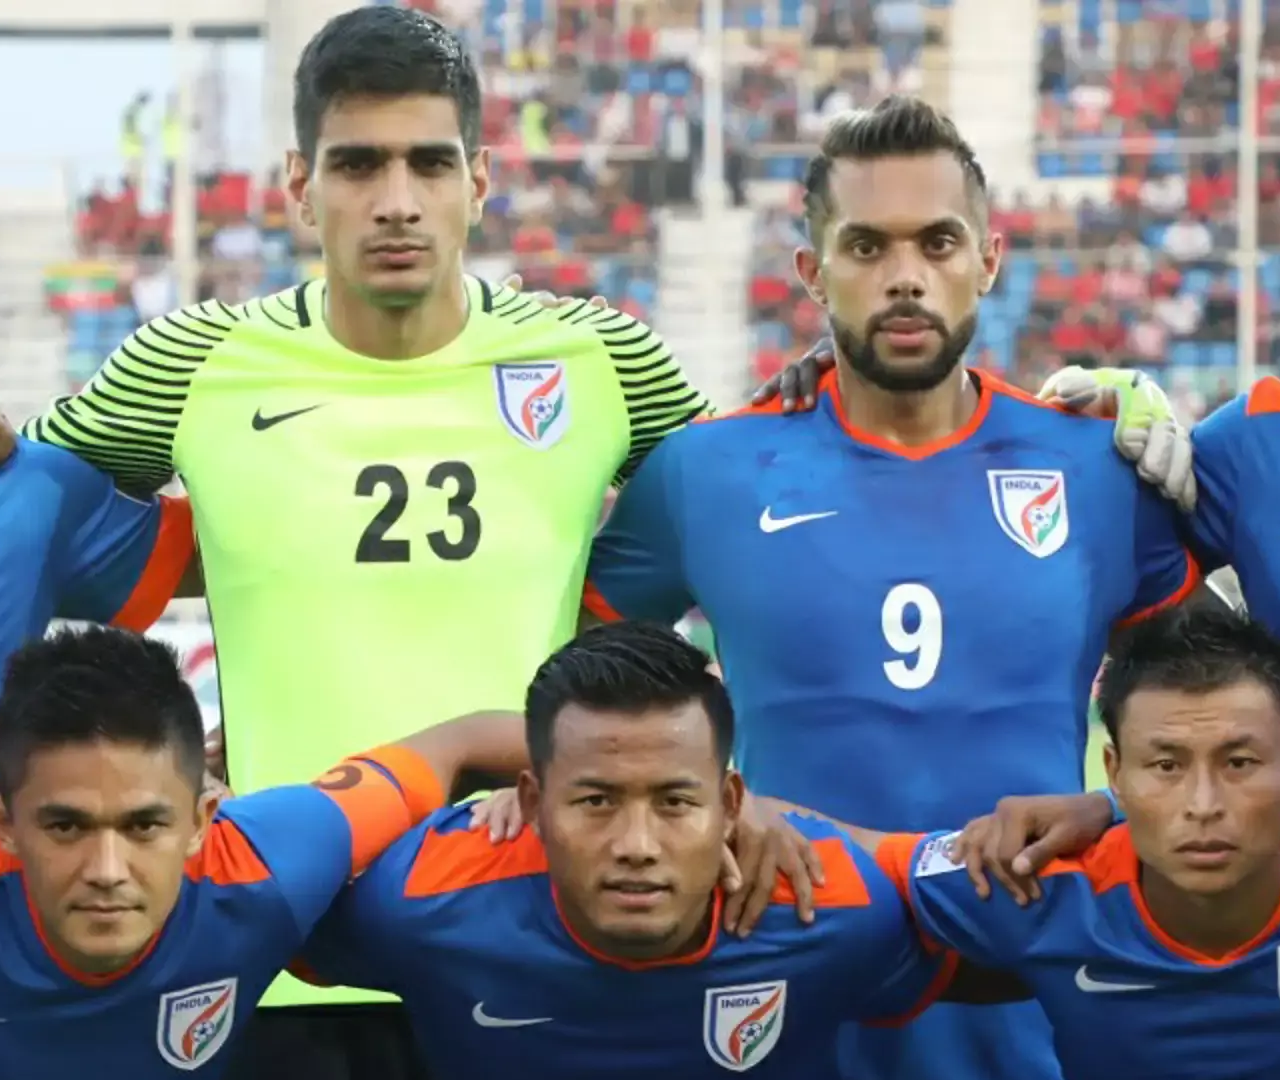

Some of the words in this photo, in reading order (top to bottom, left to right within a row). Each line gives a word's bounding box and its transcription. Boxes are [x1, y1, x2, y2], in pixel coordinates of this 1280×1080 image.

[504, 371, 544, 382] INDIA
[1004, 479, 1042, 491] INDIA
[354, 461, 482, 563] 23
[881, 583, 943, 690] 9
[175, 995, 212, 1012] INDIA
[721, 996, 760, 1008] INDIA
